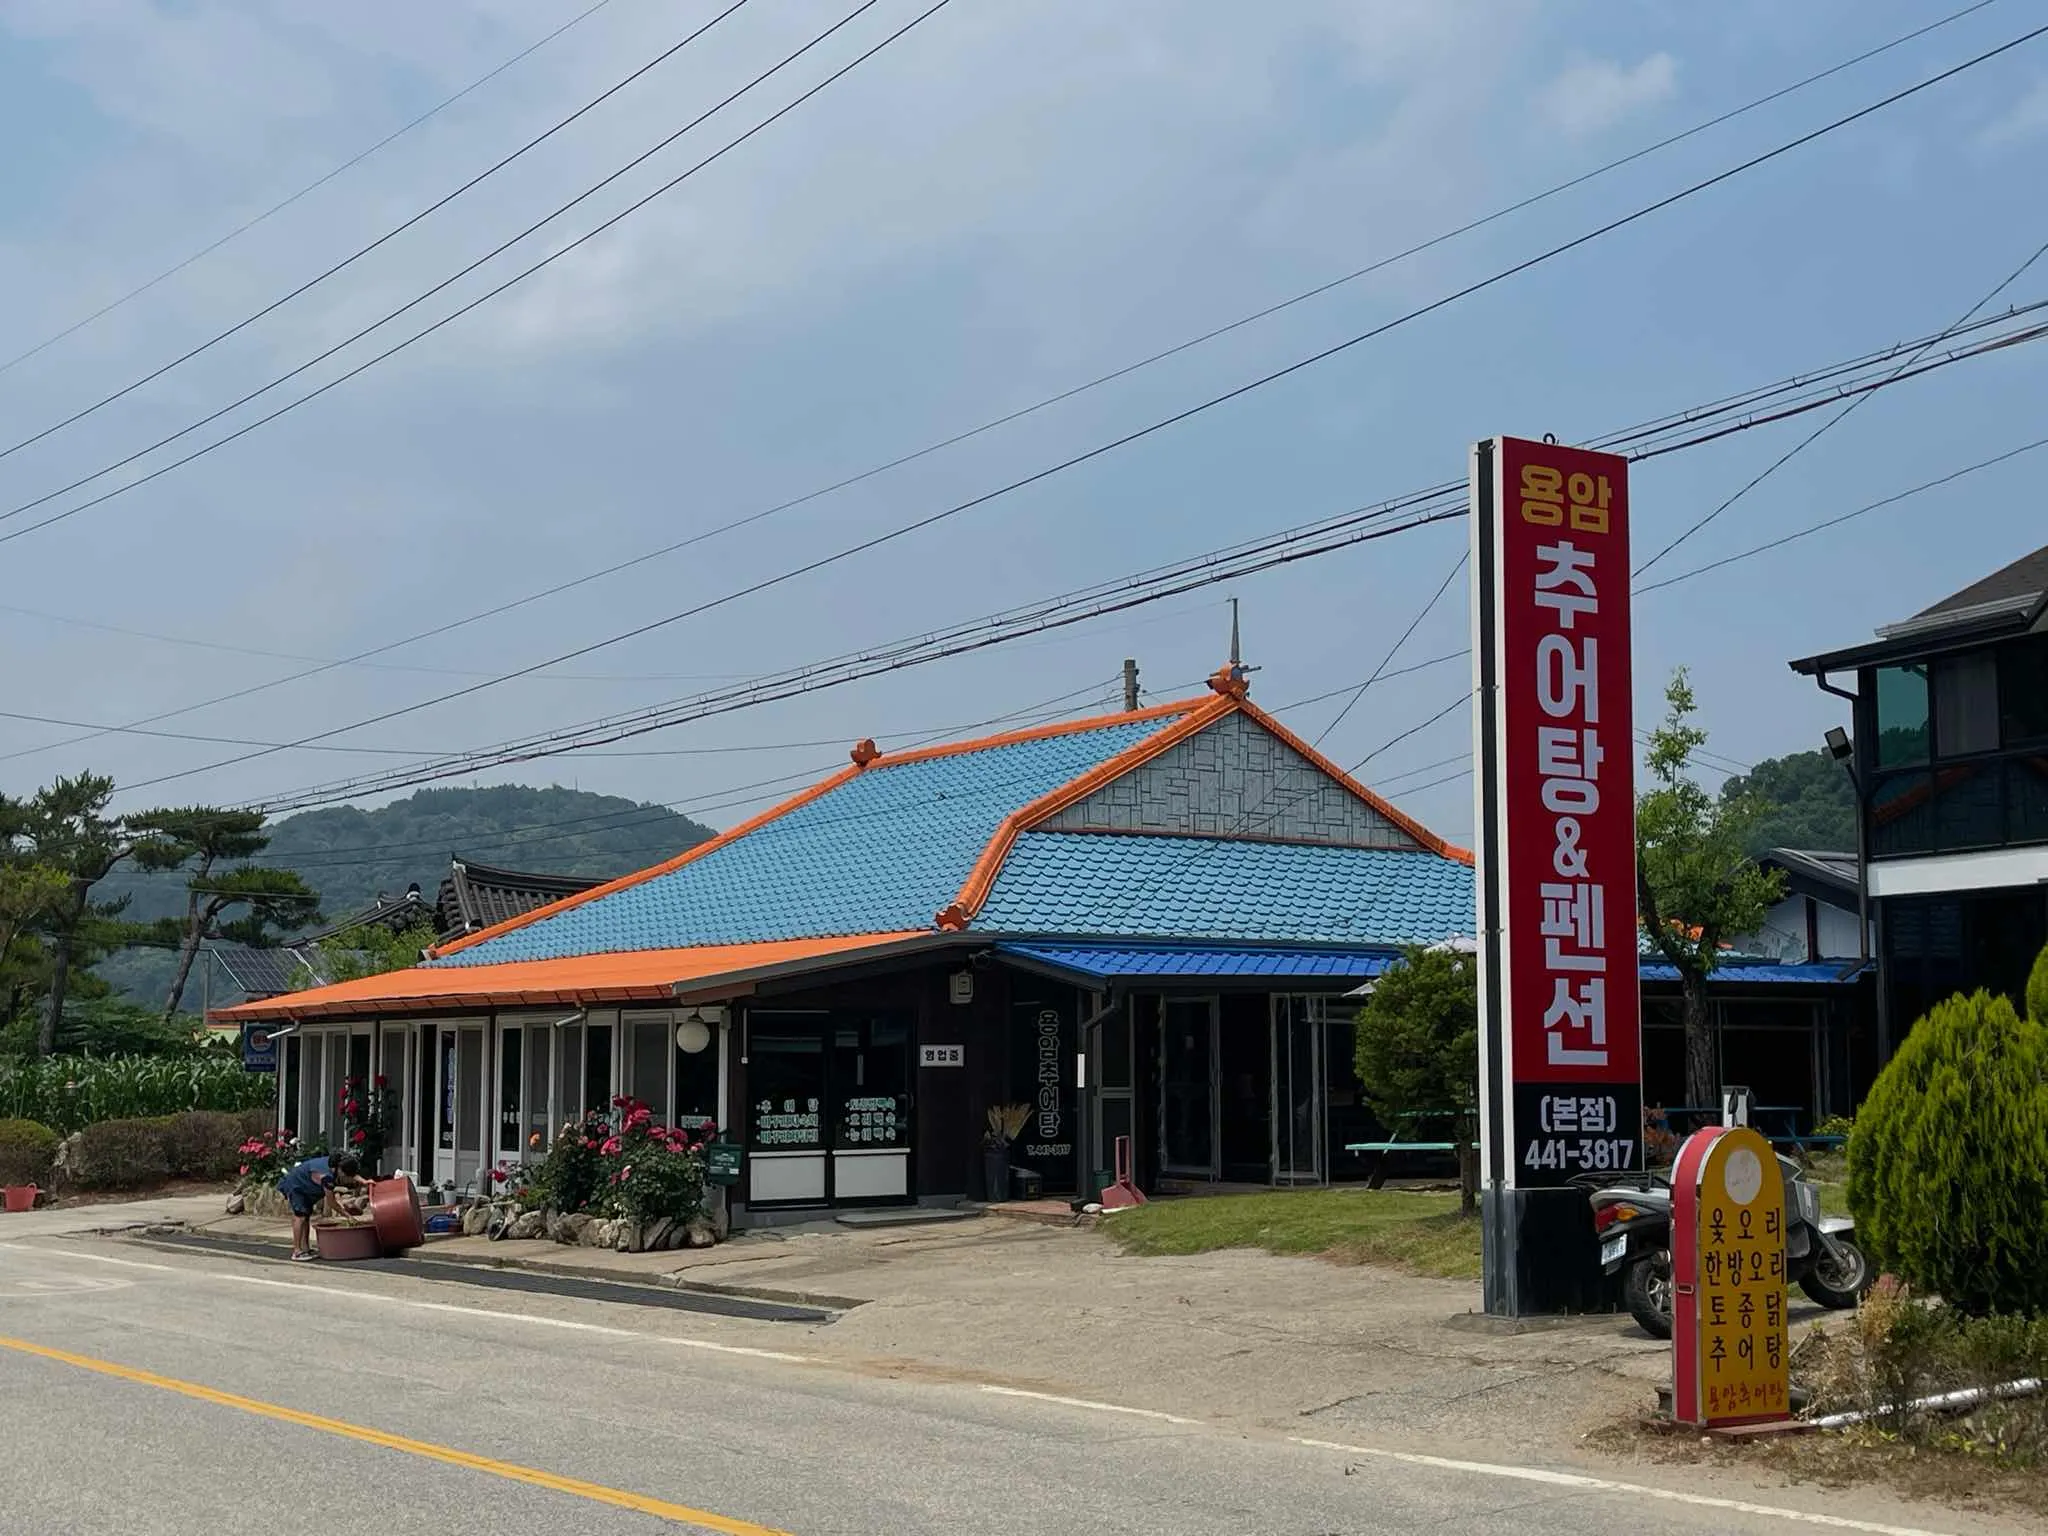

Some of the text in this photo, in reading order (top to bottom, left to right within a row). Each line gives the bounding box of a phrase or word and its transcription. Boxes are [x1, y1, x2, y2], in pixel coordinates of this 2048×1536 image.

[1520, 464, 1612, 535] 용암
[1534, 540, 1608, 1066] 추어탕&펜션
[925, 1049, 959, 1061] 영업중
[1038, 1009, 1060, 1138] 용암추어탕
[1540, 1095, 1616, 1134] (본점)
[1525, 1139, 1633, 1171] 441-3817
